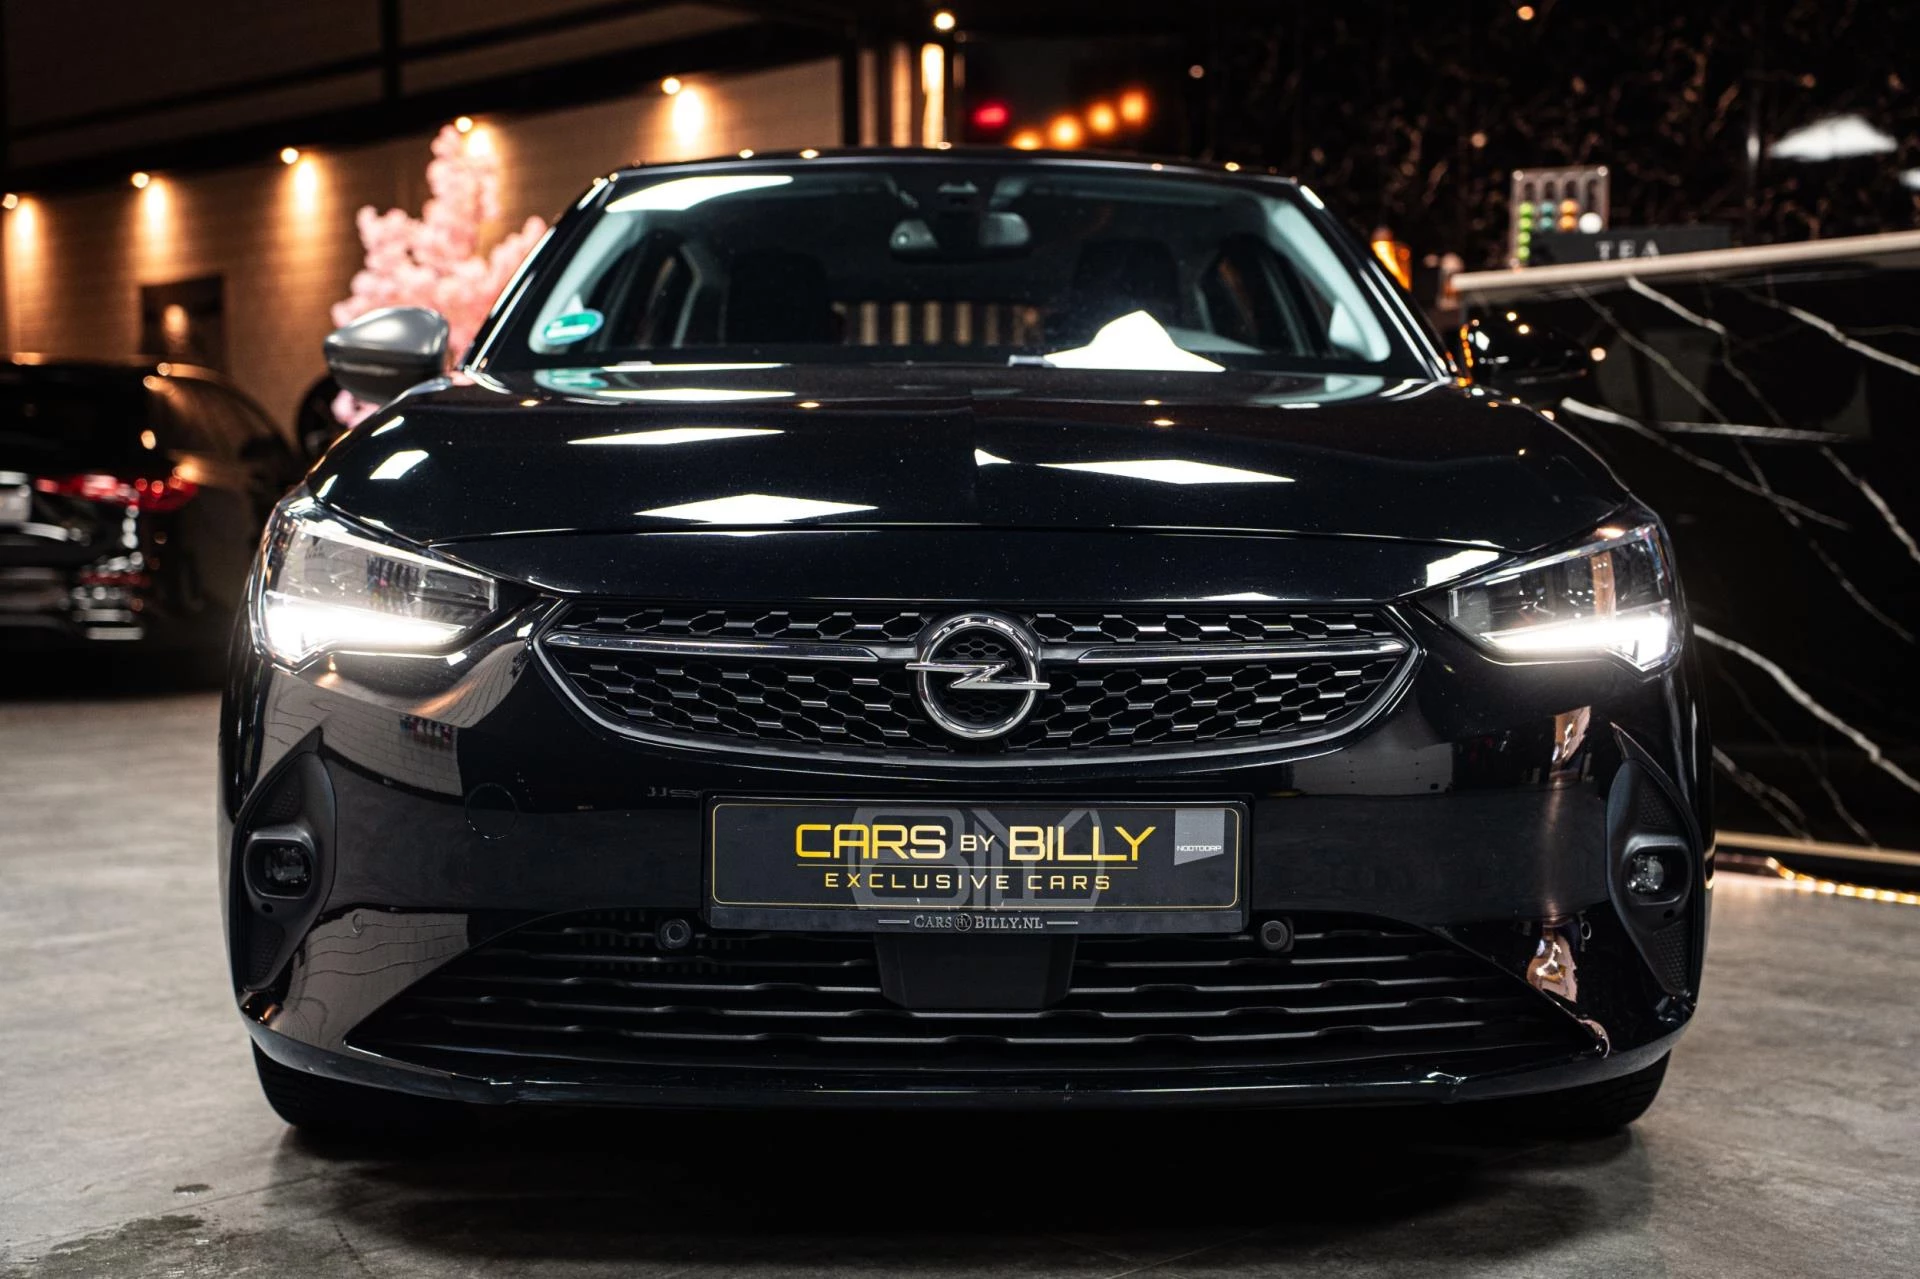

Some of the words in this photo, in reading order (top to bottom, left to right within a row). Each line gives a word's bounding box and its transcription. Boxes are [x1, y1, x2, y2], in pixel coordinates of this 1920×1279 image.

[1595, 239, 1659, 259] TEA
[796, 824, 946, 859] CARS
[960, 834, 996, 852] BY
[1009, 826, 1156, 861] BILLY
[825, 873, 1010, 890] EXCLUSIVE
[1027, 875, 1110, 890] CARS
